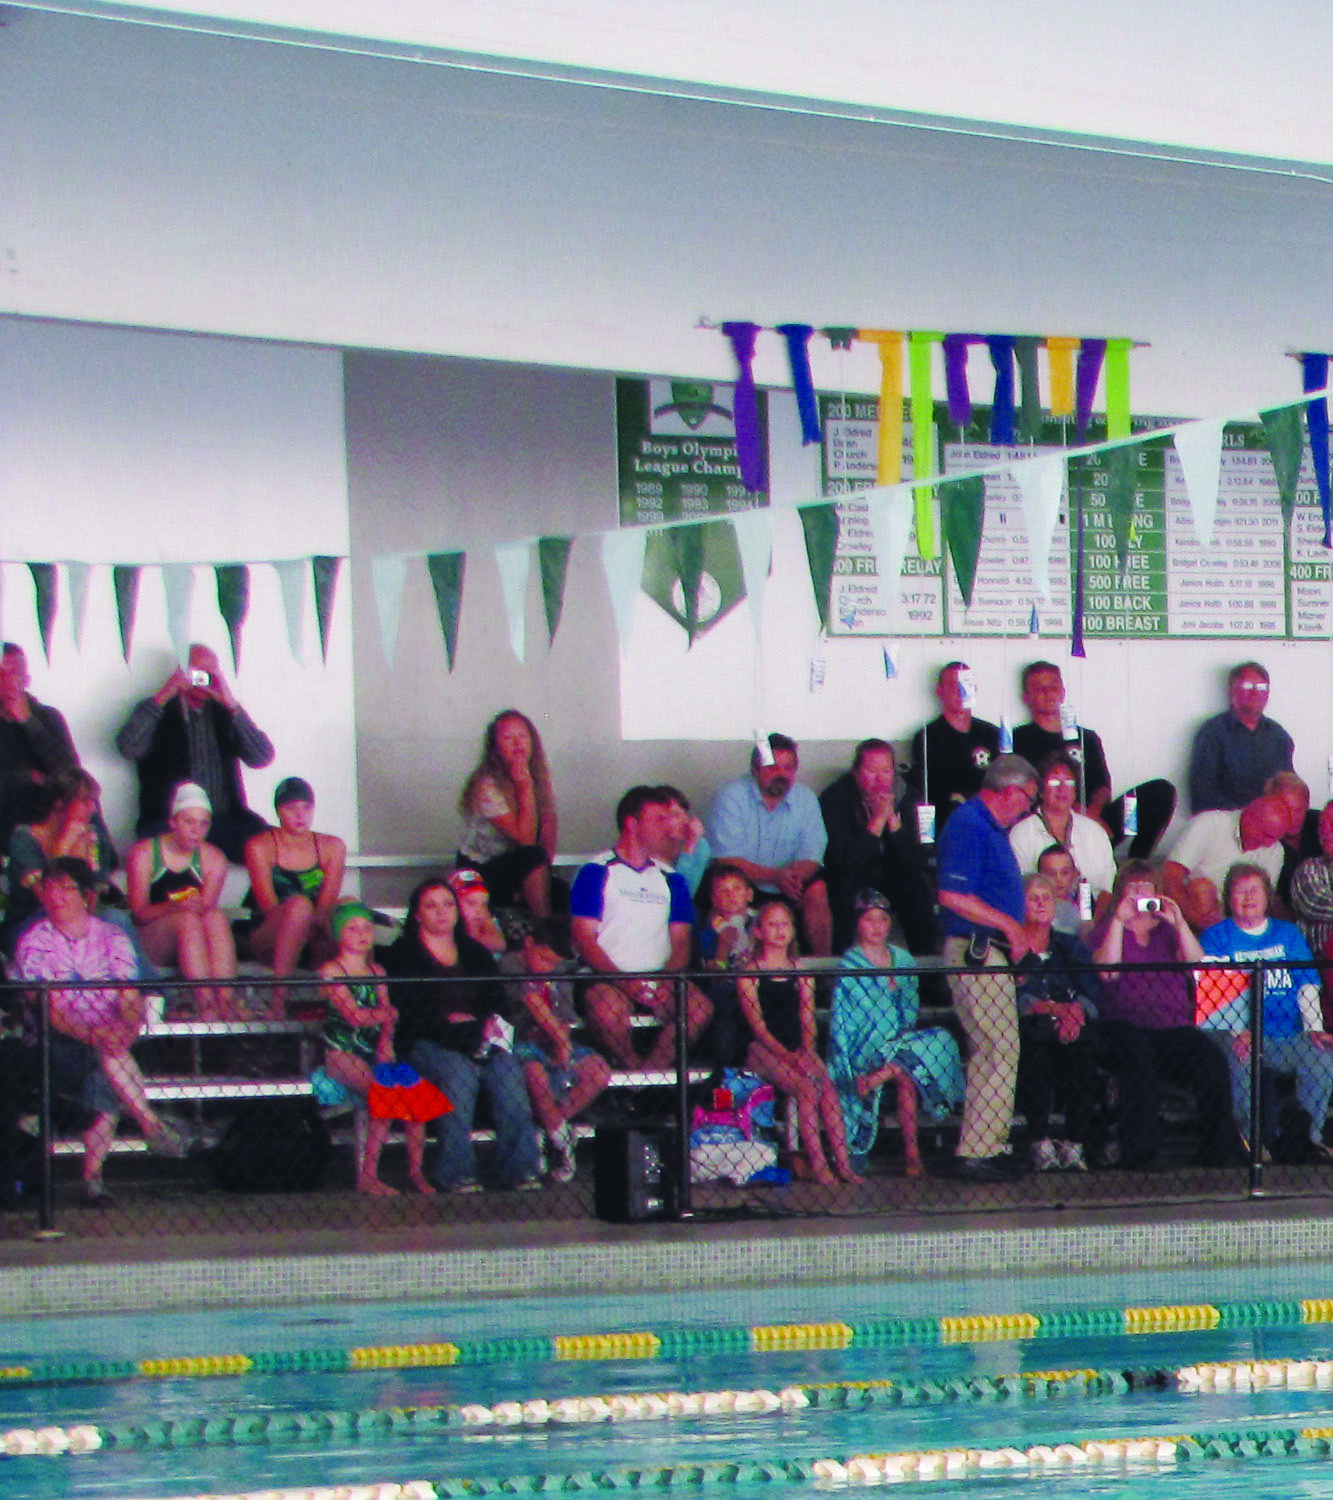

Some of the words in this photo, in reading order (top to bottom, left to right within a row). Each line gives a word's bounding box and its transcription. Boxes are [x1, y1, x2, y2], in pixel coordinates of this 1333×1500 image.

[641, 439, 679, 459] Boys
[682, 441, 738, 461] Olympi
[634, 458, 689, 477] League
[693, 459, 742, 479] Cham
[1096, 534, 1116, 549] 100
[1089, 555, 1112, 569] 100
[1290, 565, 1312, 579] 400
[1089, 575, 1112, 590] 500
[1115, 575, 1151, 590] FREE
[1089, 595, 1111, 610] 100
[1113, 595, 1153, 611] BACK
[1082, 615, 1103, 631] 100
[1105, 615, 1161, 631] BREAST
